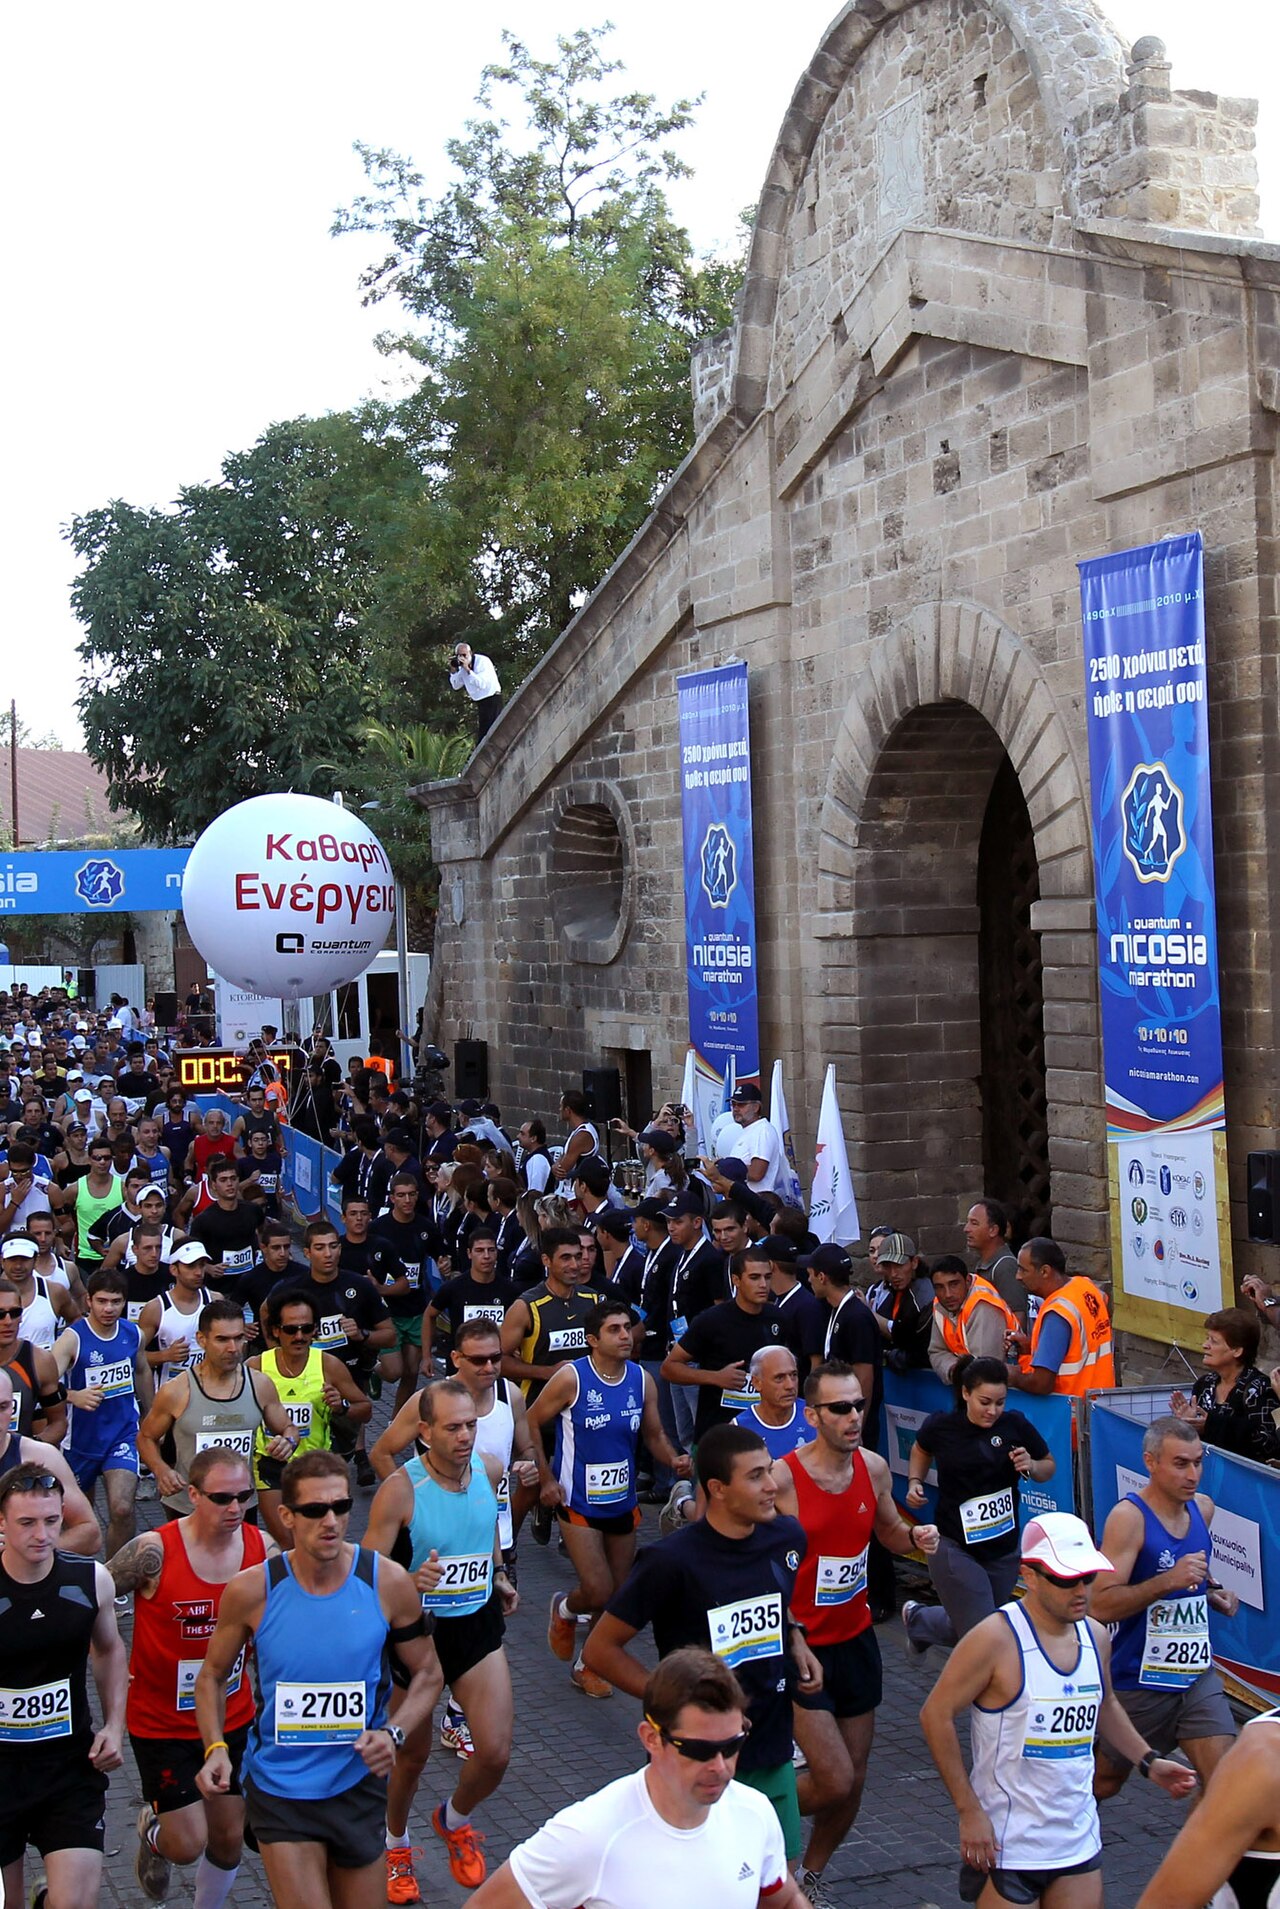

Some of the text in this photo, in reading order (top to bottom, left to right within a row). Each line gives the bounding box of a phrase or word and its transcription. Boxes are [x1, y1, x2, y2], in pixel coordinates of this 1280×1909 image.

[1156, 593, 1182, 607] 2010
[1089, 654, 1120, 682] 2500
[1122, 648, 1168, 680] χρόνια
[1125, 690, 1135, 713] η
[1137, 680, 1174, 709] σειρά
[1176, 680, 1203, 704] σου
[683, 745, 702, 764] 2500
[703, 771, 709, 788] η
[709, 765, 732, 786] σειρά
[732, 766, 748, 783] σου
[266, 834, 388, 873] Καθαρή
[1134, 917, 1181, 930] quantum
[693, 945, 752, 967] nicosia
[1110, 933, 1207, 966] nicosia
[702, 969, 742, 983] marathon
[1128, 968, 1195, 988] marathon
[182, 1351, 206, 1368] 278
[100, 1364, 130, 1385] 2759
[585, 1413, 611, 1428] Pokka
[600, 1465, 629, 1487] 2765
[978, 1494, 1012, 1522] 2838
[1021, 1492, 1057, 1511] nicosia
[445, 1560, 489, 1585] 2764
[1213, 1547, 1255, 1578] Municipality
[187, 1605, 209, 1616] ABF
[730, 1602, 780, 1639] 2535
[186, 1626, 203, 1634] THE
[1164, 1641, 1209, 1664] 2824
[12, 1688, 69, 1719] 2892
[301, 1691, 364, 1718] 2703
[1050, 1704, 1097, 1733] 2689
